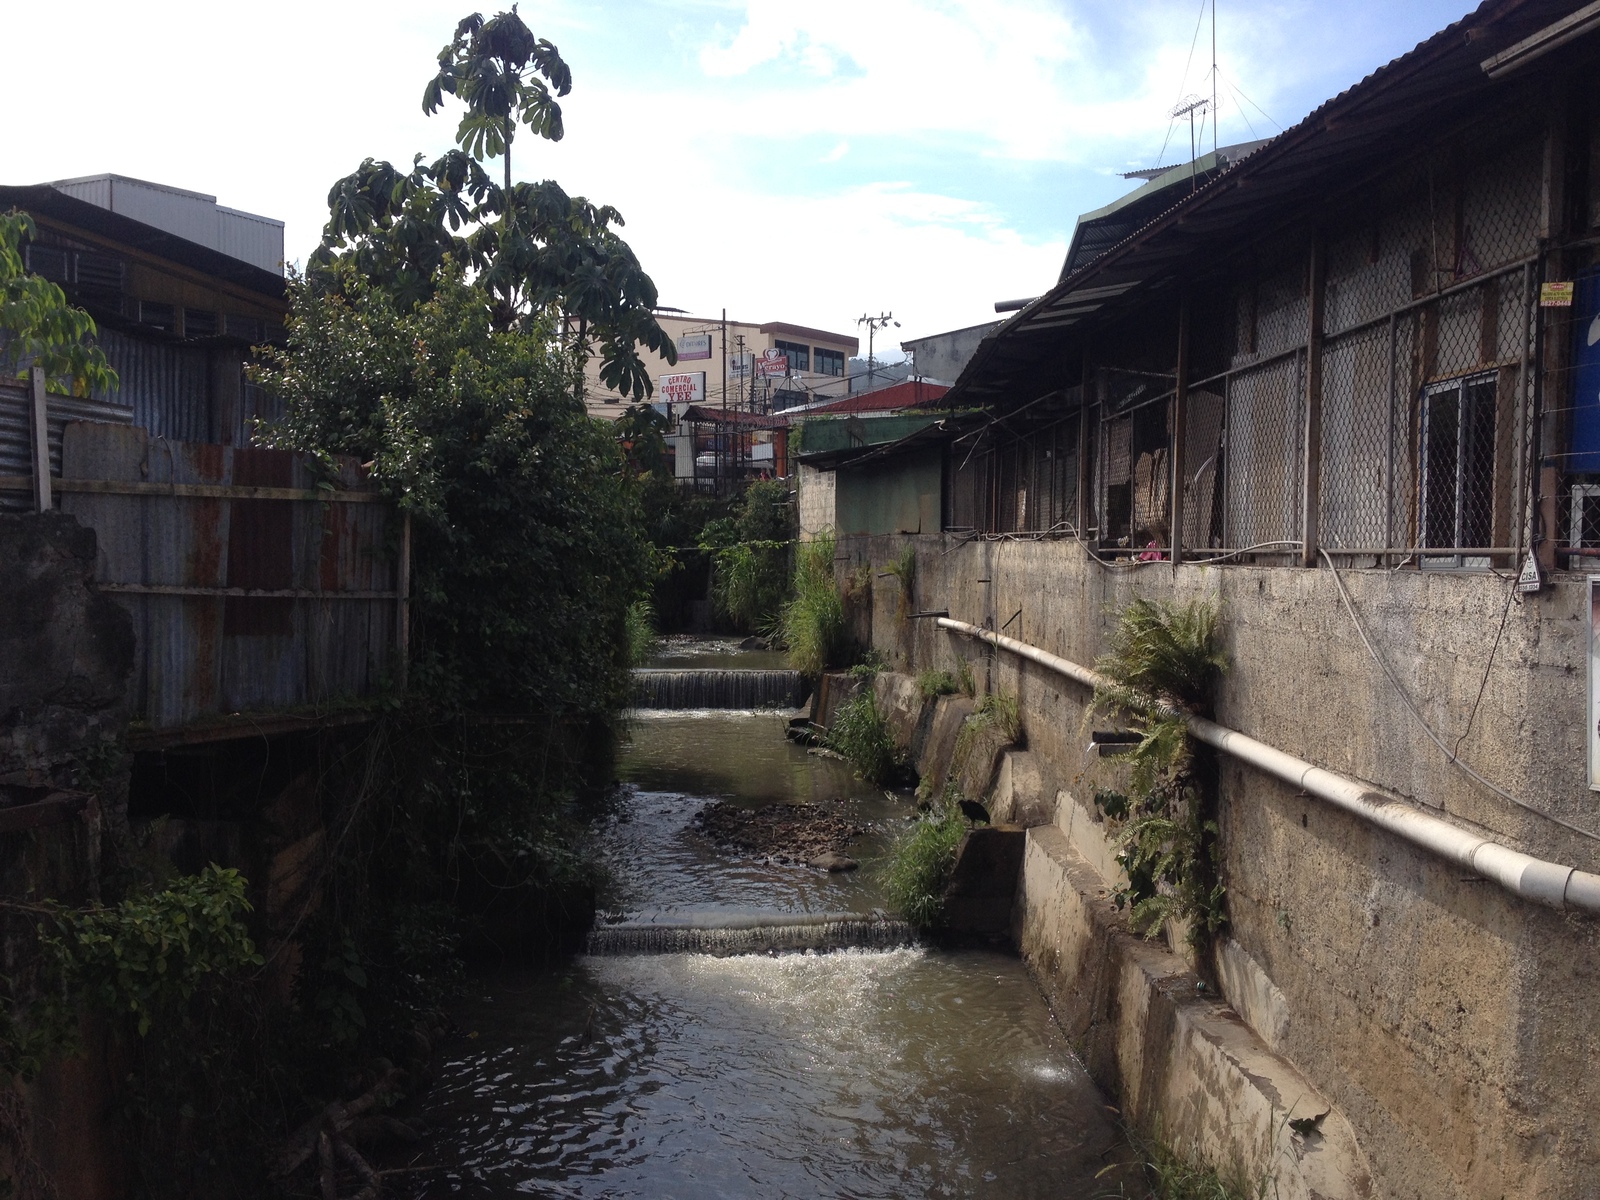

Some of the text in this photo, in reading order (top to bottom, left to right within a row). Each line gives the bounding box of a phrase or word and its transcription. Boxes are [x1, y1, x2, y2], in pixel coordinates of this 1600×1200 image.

[757, 362, 785, 371] Merayo
[668, 376, 692, 385] CENTRO
[661, 384, 697, 393] COMERCIAL
[668, 392, 692, 401] YEE
[1522, 571, 1536, 581] CISA
